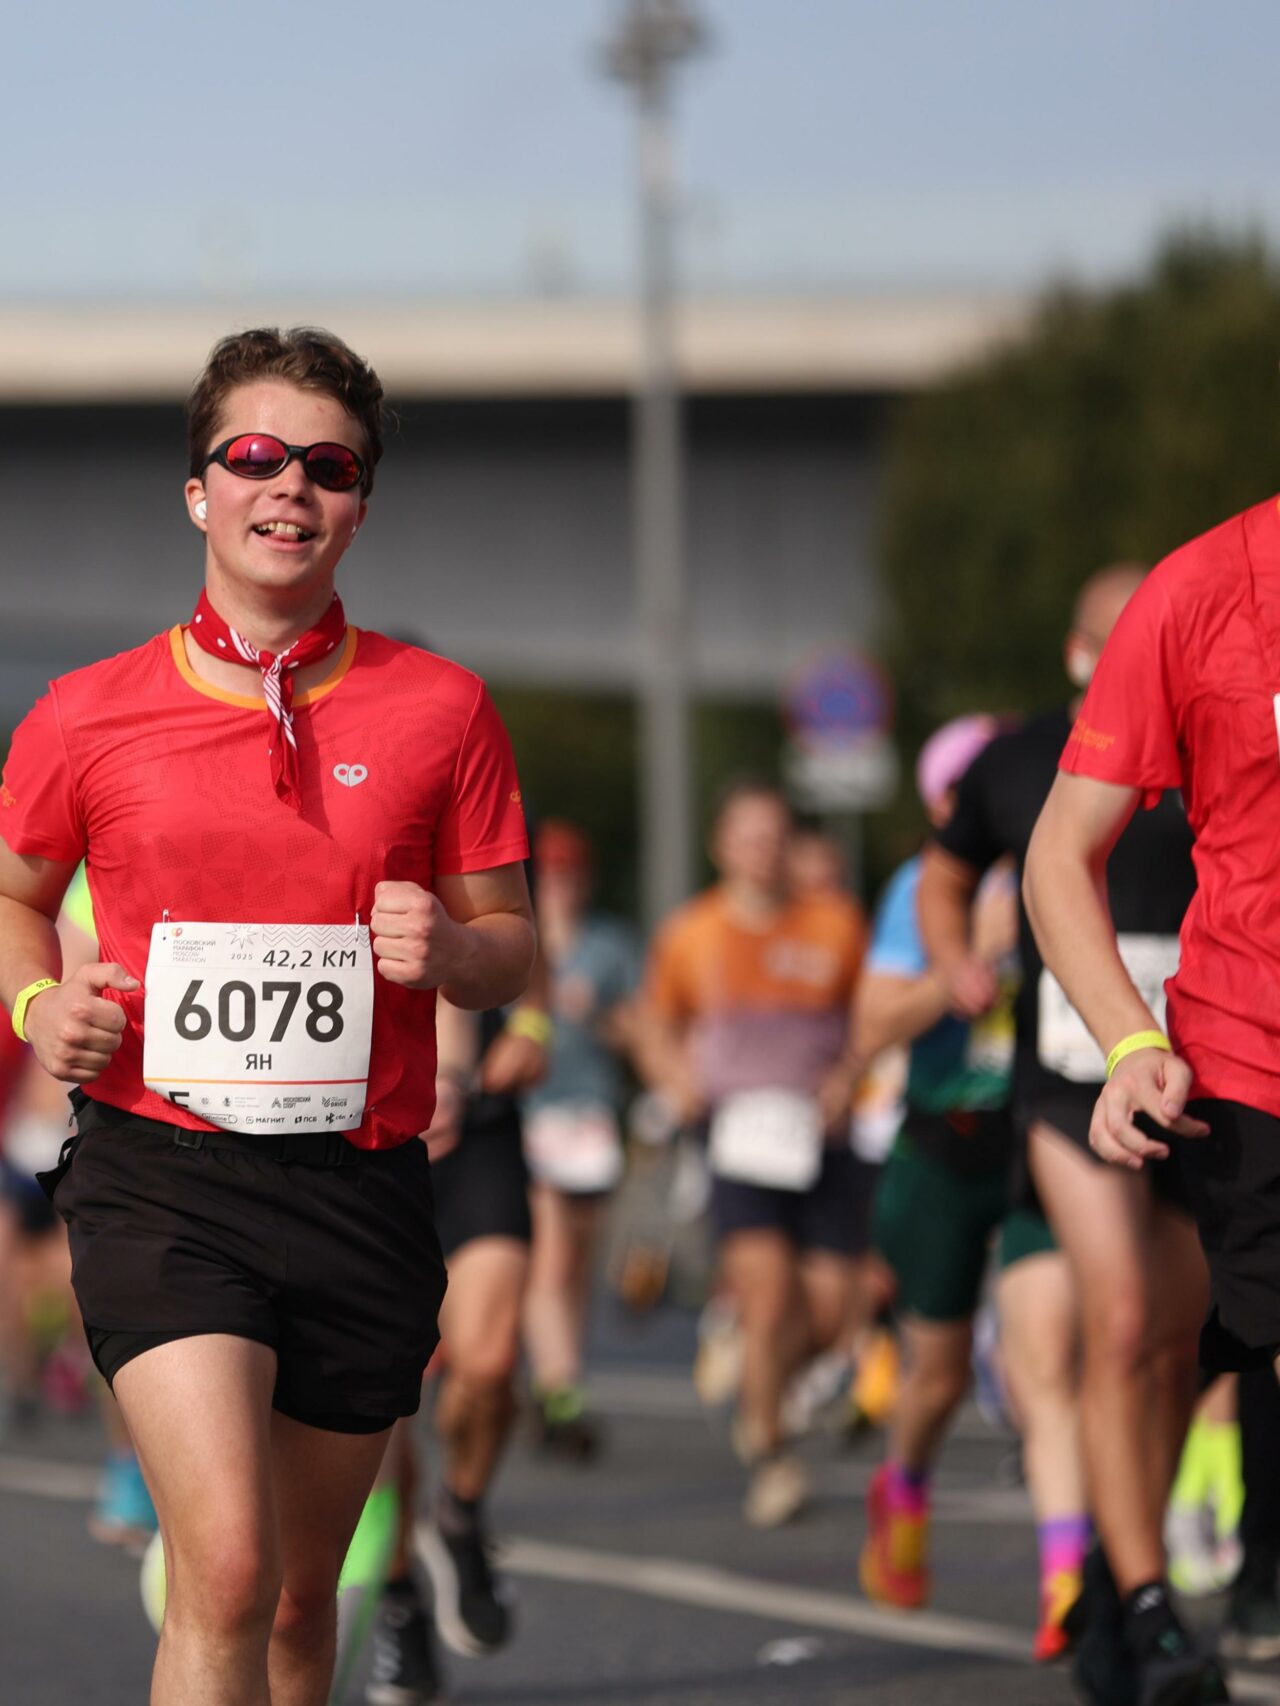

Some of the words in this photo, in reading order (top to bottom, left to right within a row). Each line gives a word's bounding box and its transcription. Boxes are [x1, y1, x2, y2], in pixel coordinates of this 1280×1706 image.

[262, 949, 313, 970] 42,2
[174, 979, 344, 1043] 6078
[245, 1053, 272, 1070] ЯН
[255, 1116, 286, 1124] МАГНИТ
